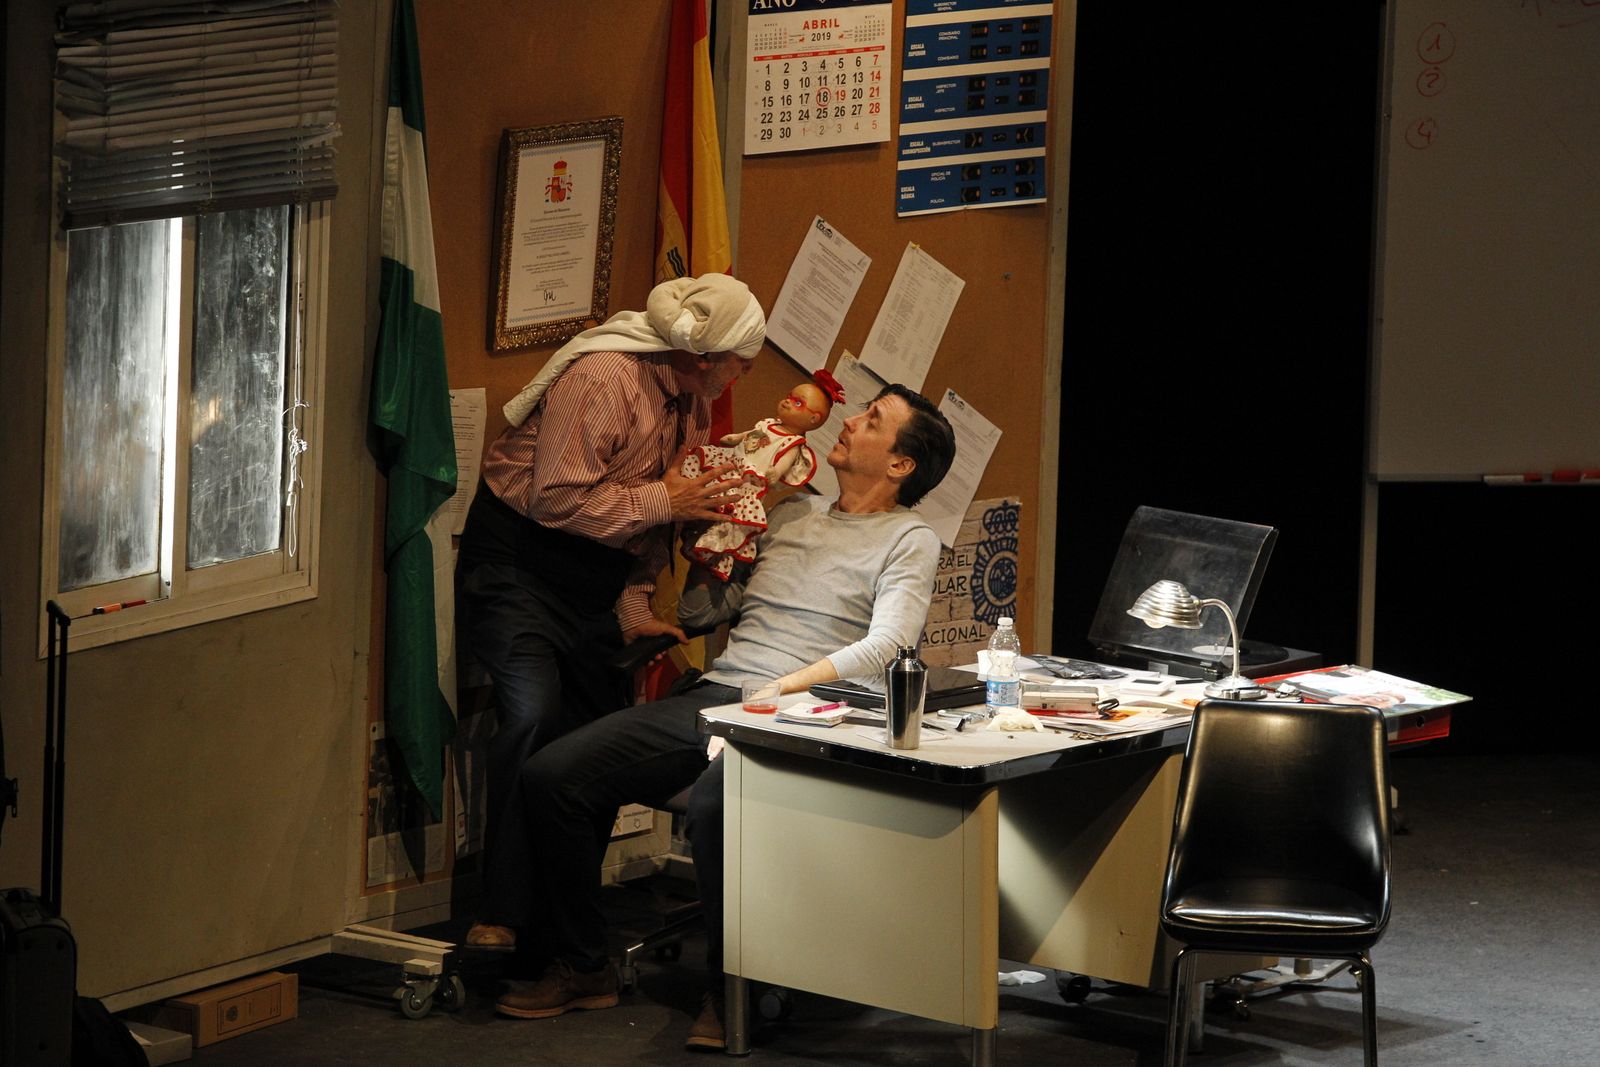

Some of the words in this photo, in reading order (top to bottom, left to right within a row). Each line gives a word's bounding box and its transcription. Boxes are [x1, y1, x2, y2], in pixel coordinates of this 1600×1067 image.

[803, 18, 840, 30] ABRIL
[811, 32, 831, 42] 2019
[765, 64, 770, 75] 1
[783, 62, 790, 73] 2
[802, 61, 808, 72] 3
[820, 59, 826, 70] 4
[838, 58, 844, 68] 5
[855, 56, 862, 67] 6
[873, 55, 879, 65] 7
[764, 80, 771, 91] 8
[783, 79, 789, 89] 9
[799, 77, 810, 88] 10
[817, 75, 827, 86] 11
[835, 73, 846, 85] 12
[852, 72, 864, 83] 13
[870, 71, 881, 81] 14
[761, 96, 773, 108] 15
[780, 95, 792, 106] 16
[799, 93, 810, 104] 17
[817, 91, 828, 102] 18
[835, 90, 846, 101] 19
[852, 88, 863, 99] 20
[869, 86, 880, 97] 21
[760, 112, 773, 124] 22
[780, 111, 791, 122] 23
[798, 109, 810, 120] 24
[816, 107, 828, 119] 25
[834, 106, 846, 117] 26
[851, 104, 863, 115] 27
[869, 102, 880, 114] 28
[760, 128, 773, 140] 29
[779, 127, 791, 138] 30
[819, 125, 825, 135] 2
[837, 124, 842, 133] 3
[854, 122, 859, 132] 4
[872, 120, 877, 130] 5
[957, 554, 972, 567] EL
